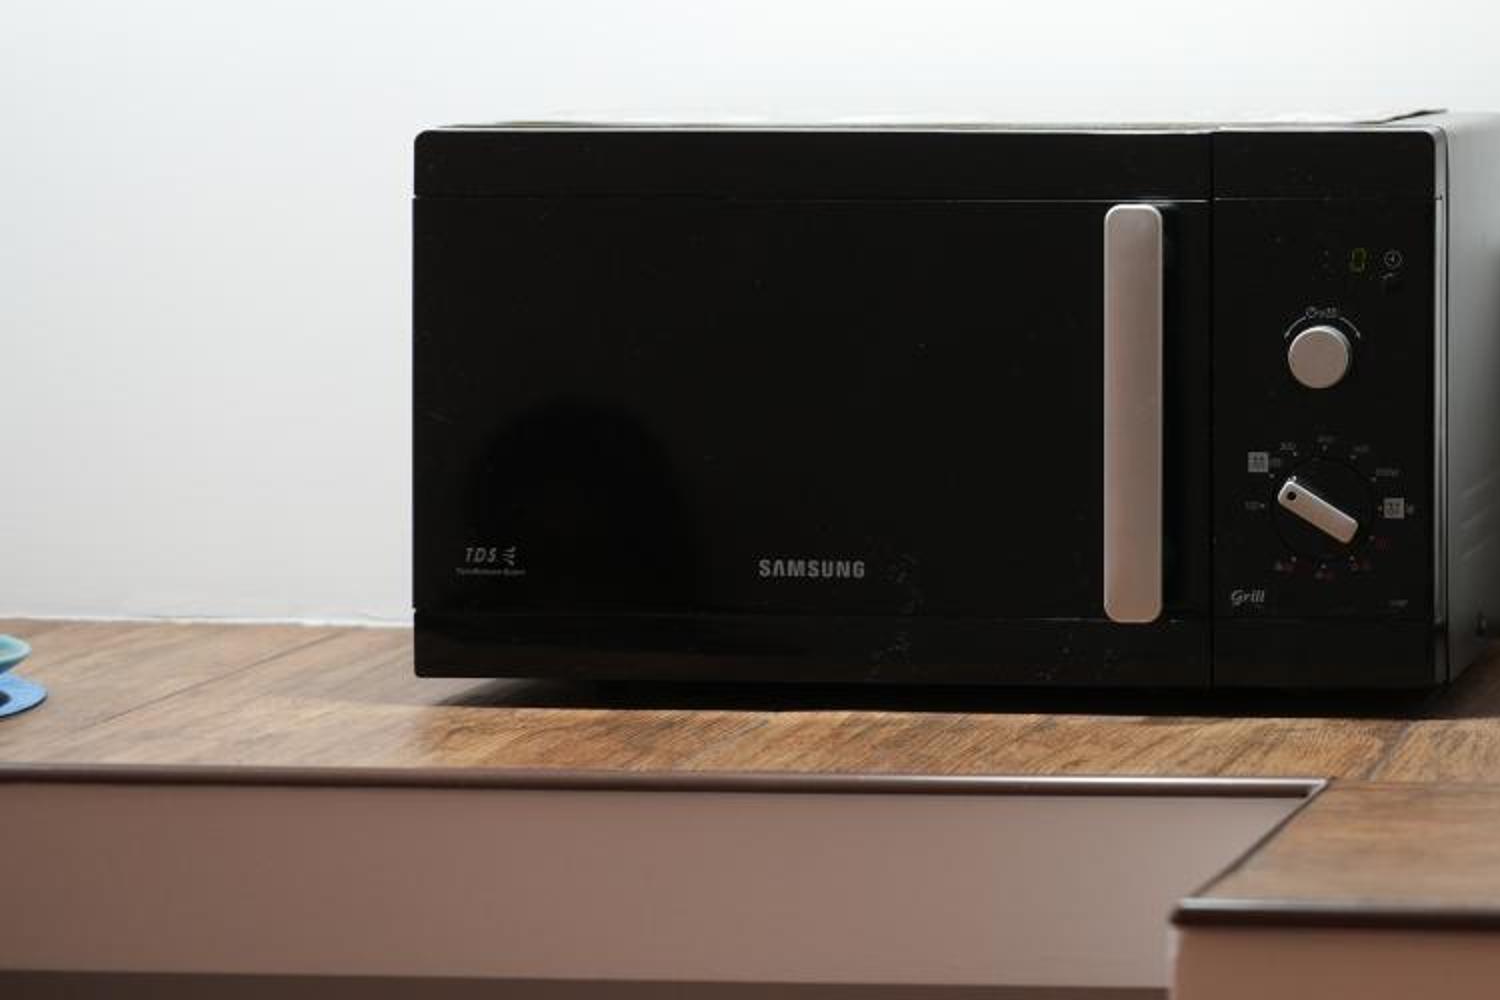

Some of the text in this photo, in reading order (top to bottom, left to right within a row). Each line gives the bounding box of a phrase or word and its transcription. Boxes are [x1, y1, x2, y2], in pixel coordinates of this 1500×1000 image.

[465, 547, 497, 563] TDS
[758, 558, 866, 579] SAMSUNG
[1231, 589, 1265, 605] Grill
